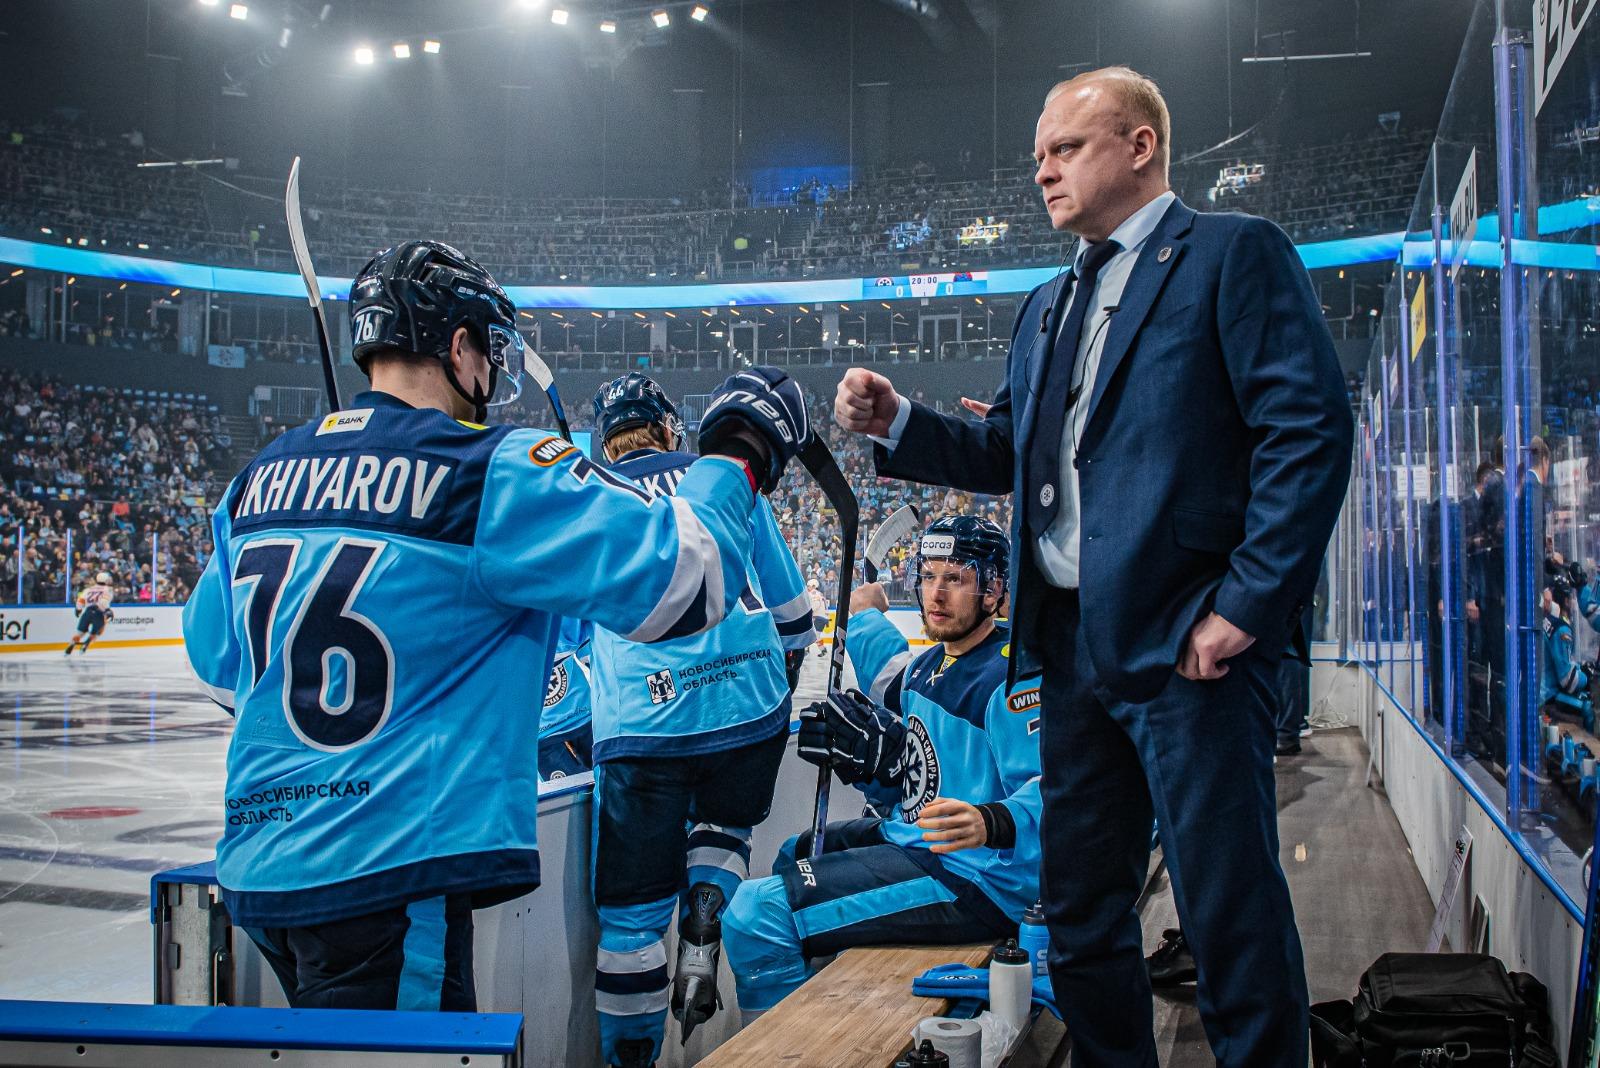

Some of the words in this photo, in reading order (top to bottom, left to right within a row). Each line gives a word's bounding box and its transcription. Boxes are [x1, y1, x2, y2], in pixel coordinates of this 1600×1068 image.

[911, 276, 938, 285] 20:00
[945, 283, 954, 296] 0
[895, 285, 904, 298] 0
[356, 315, 374, 341] 76
[608, 384, 625, 400] 44
[337, 416, 366, 425] БАНК
[235, 455, 451, 519] KHIYAROV
[231, 536, 396, 754] 76
[678, 648, 771, 680] НОВОСИБИРСКАЯ
[683, 670, 737, 691] ОБЛАСТЬ
[923, 739, 937, 779] СИБИРЬ
[225, 781, 371, 811] ОВОСИБИРСКАЯ
[228, 807, 293, 826] ОБЛАСТЬ
